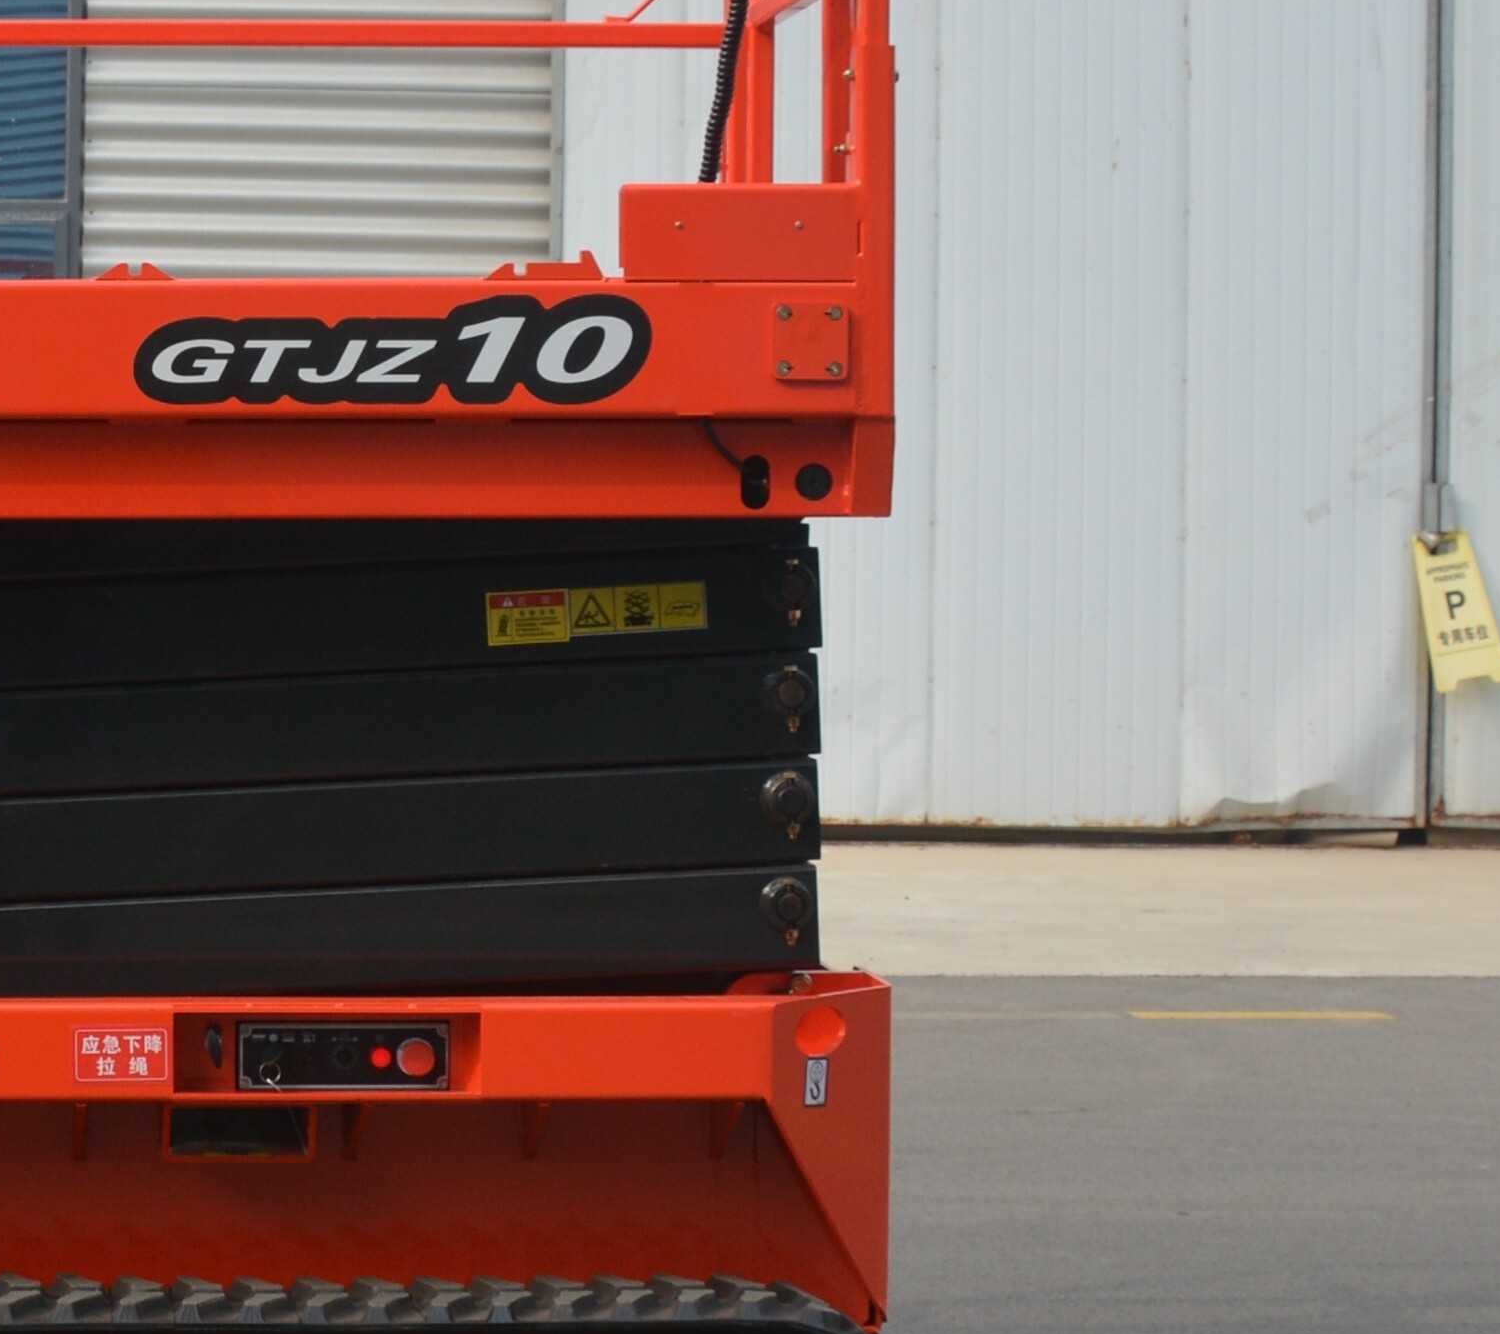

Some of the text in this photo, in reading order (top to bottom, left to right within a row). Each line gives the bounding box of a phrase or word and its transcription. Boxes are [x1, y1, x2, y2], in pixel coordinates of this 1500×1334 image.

[1445, 590, 1466, 620] P
[1438, 624, 1490, 646] 专用车位
[81, 1034, 163, 1055] 应急下降
